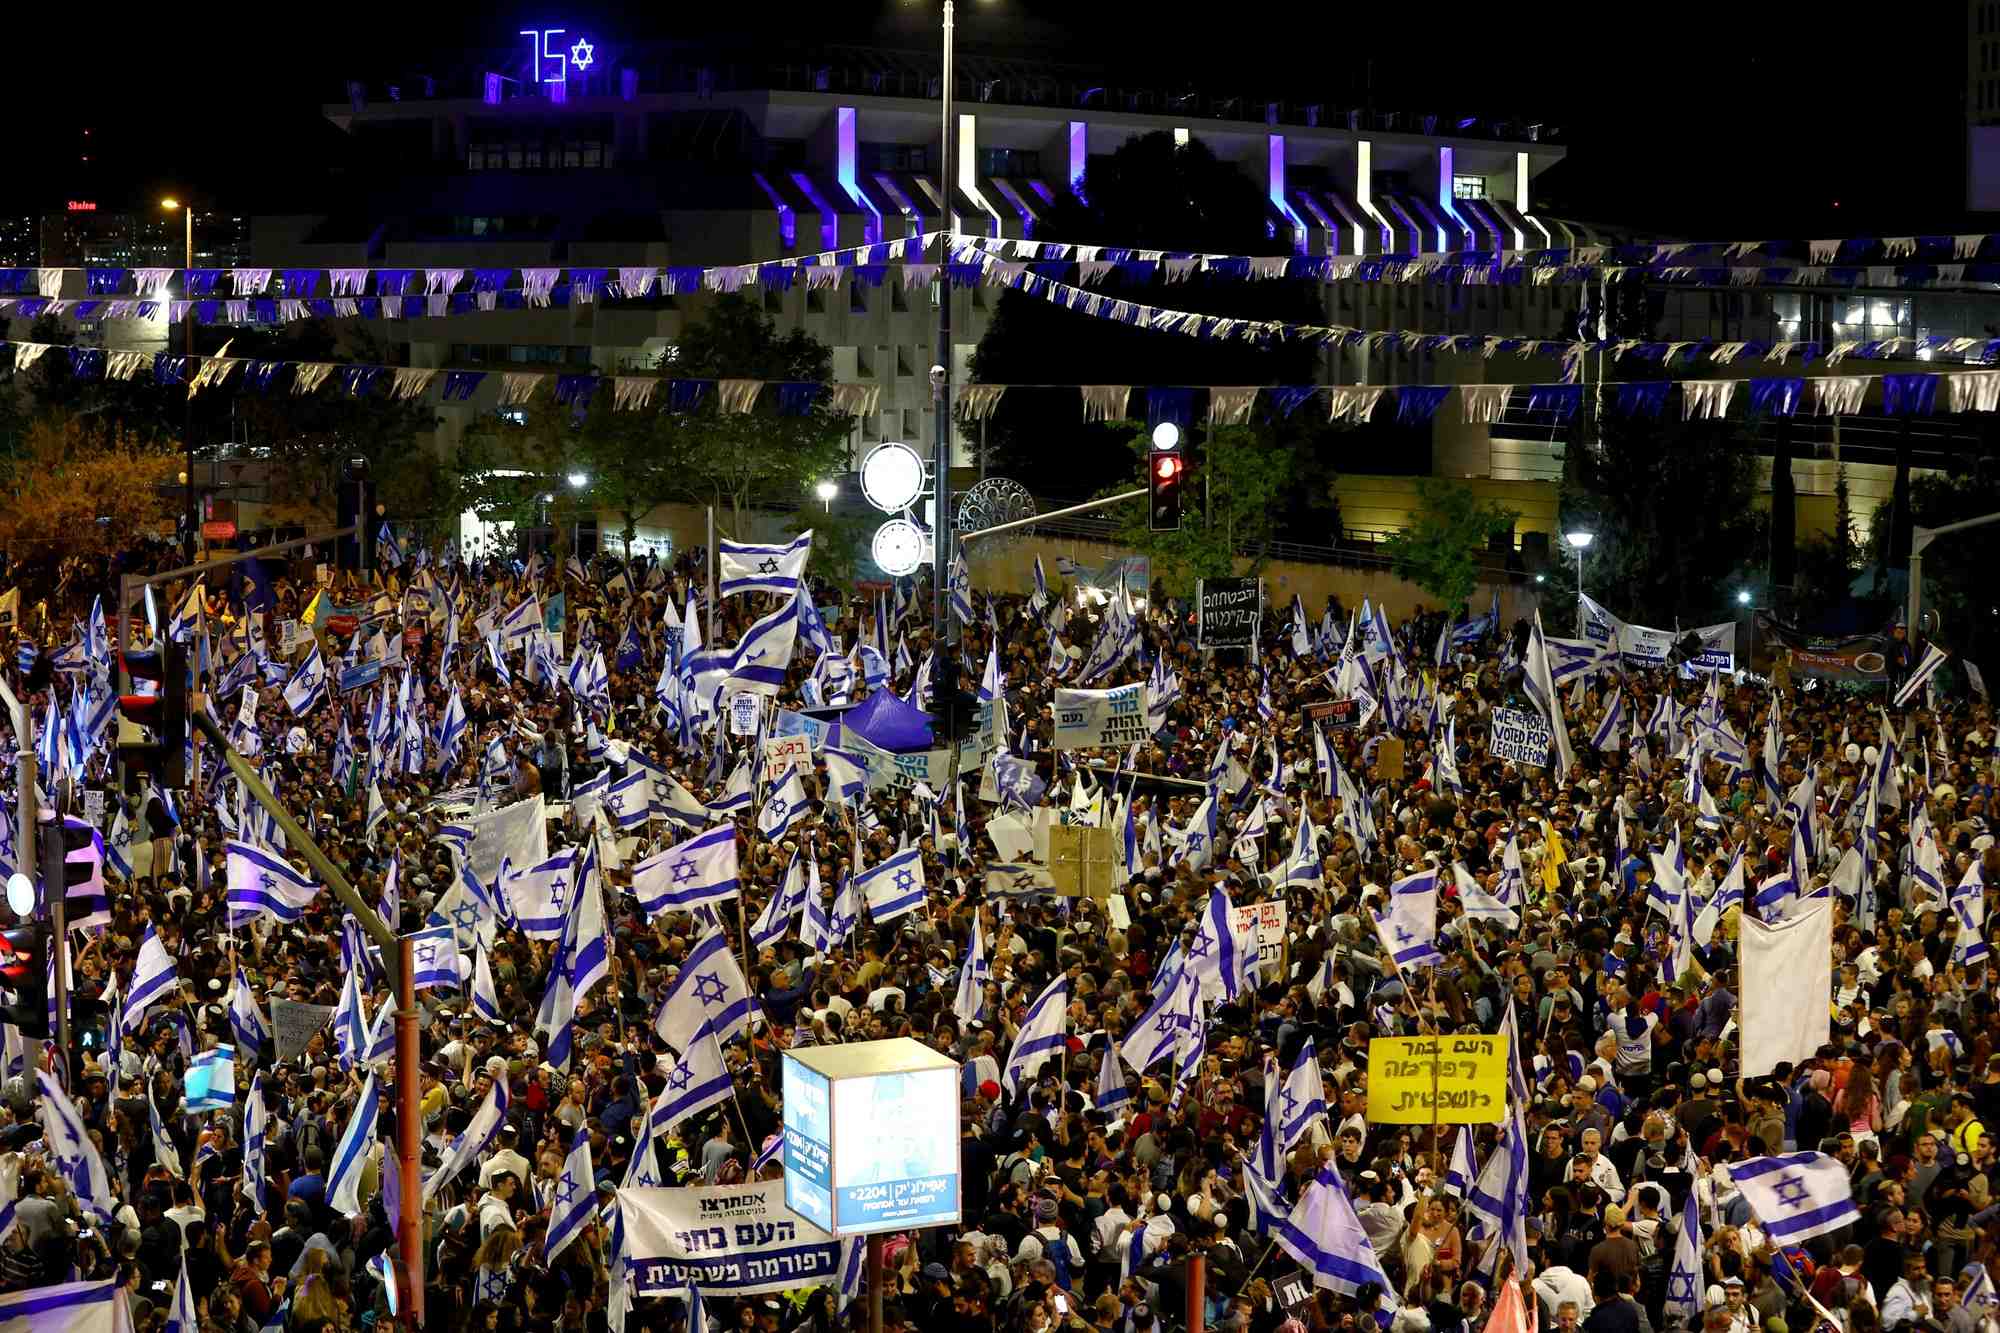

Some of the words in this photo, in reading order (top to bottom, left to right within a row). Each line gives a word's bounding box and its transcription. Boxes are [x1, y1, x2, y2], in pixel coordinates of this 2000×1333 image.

[520, 29, 565, 82] 75
[1108, 687, 1138, 701] העם
[1109, 700, 1139, 713] בחר
[1061, 713, 1083, 723] נעם
[1106, 714, 1143, 729] זהות
[1522, 713, 1549, 732] PEOPL
[1100, 727, 1151, 743] יהודית
[1493, 724, 1525, 744] VOTED
[1527, 730, 1548, 749] FOR
[1490, 739, 1516, 760] LEGAL
[1516, 745, 1547, 765] REFORM
[1402, 1041, 1442, 1056] בחר
[1453, 1040, 1493, 1056] העם
[1391, 1090, 1491, 1112] משפטית
[675, 1227, 728, 1253] בחר
[735, 1221, 795, 1246] העם
[646, 1262, 741, 1284] משפטית
[748, 1251, 831, 1280] רפורמה
